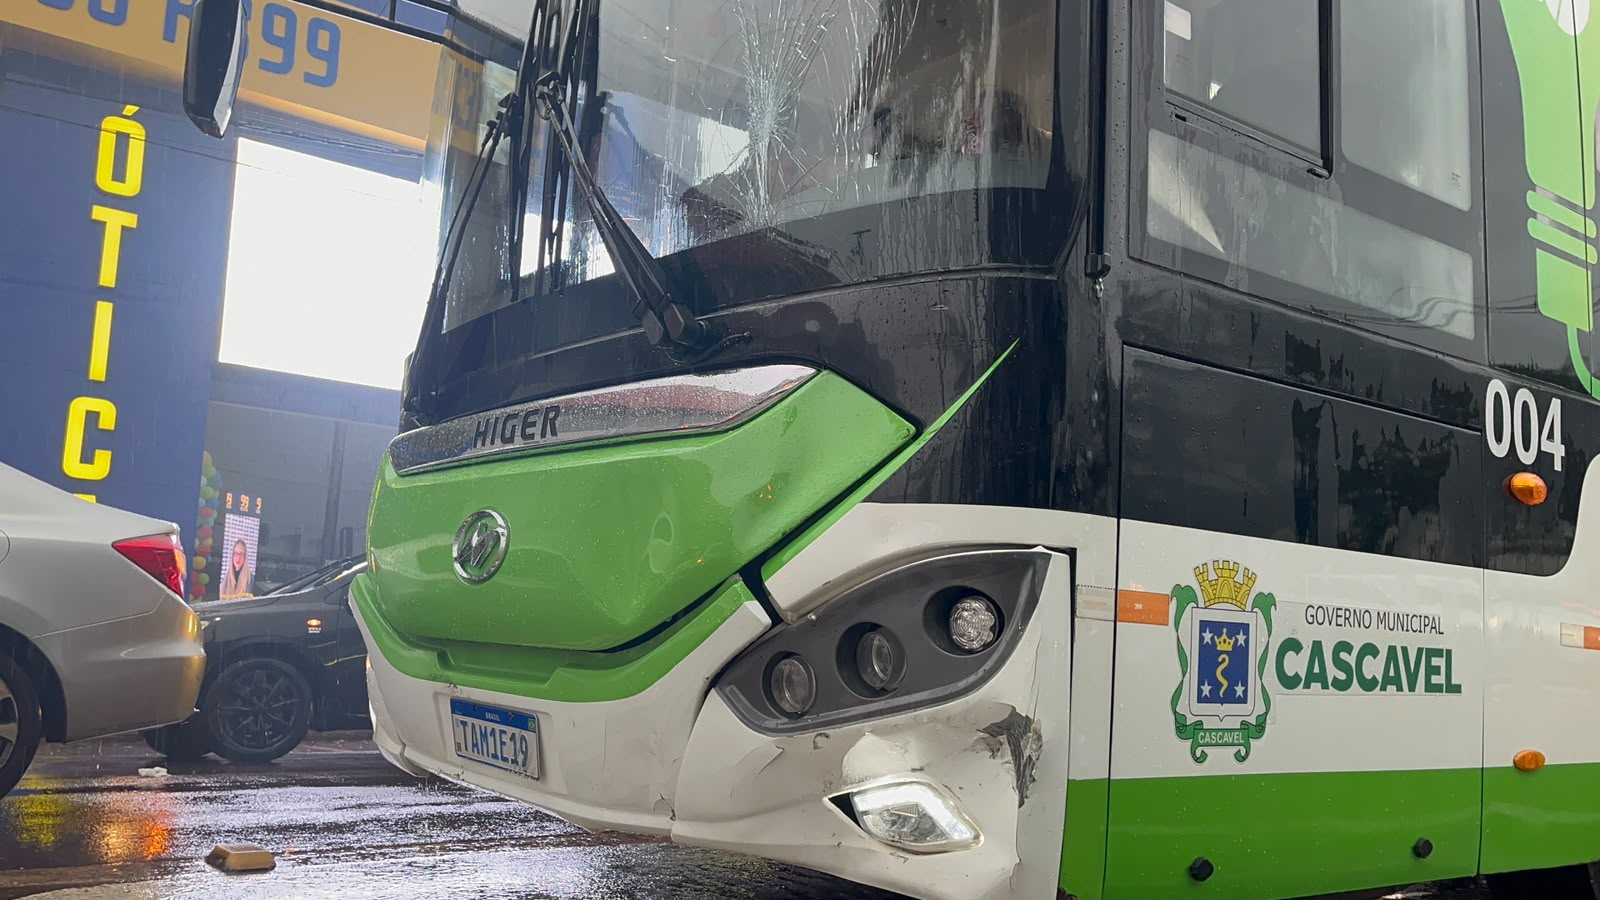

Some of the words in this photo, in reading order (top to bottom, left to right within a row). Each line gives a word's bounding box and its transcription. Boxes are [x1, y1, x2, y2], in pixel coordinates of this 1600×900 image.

[62, 104, 147, 504] ÓTIC
[473, 404, 561, 449] HIGER
[1485, 378, 1566, 472] 004
[1305, 604, 1372, 629] GOVERNO
[1376, 611, 1445, 635] MUNICIPAL
[1275, 637, 1462, 694] CASCAVEL
[459, 719, 528, 768] TAM1E19
[1198, 731, 1245, 744] CASCAVEL
